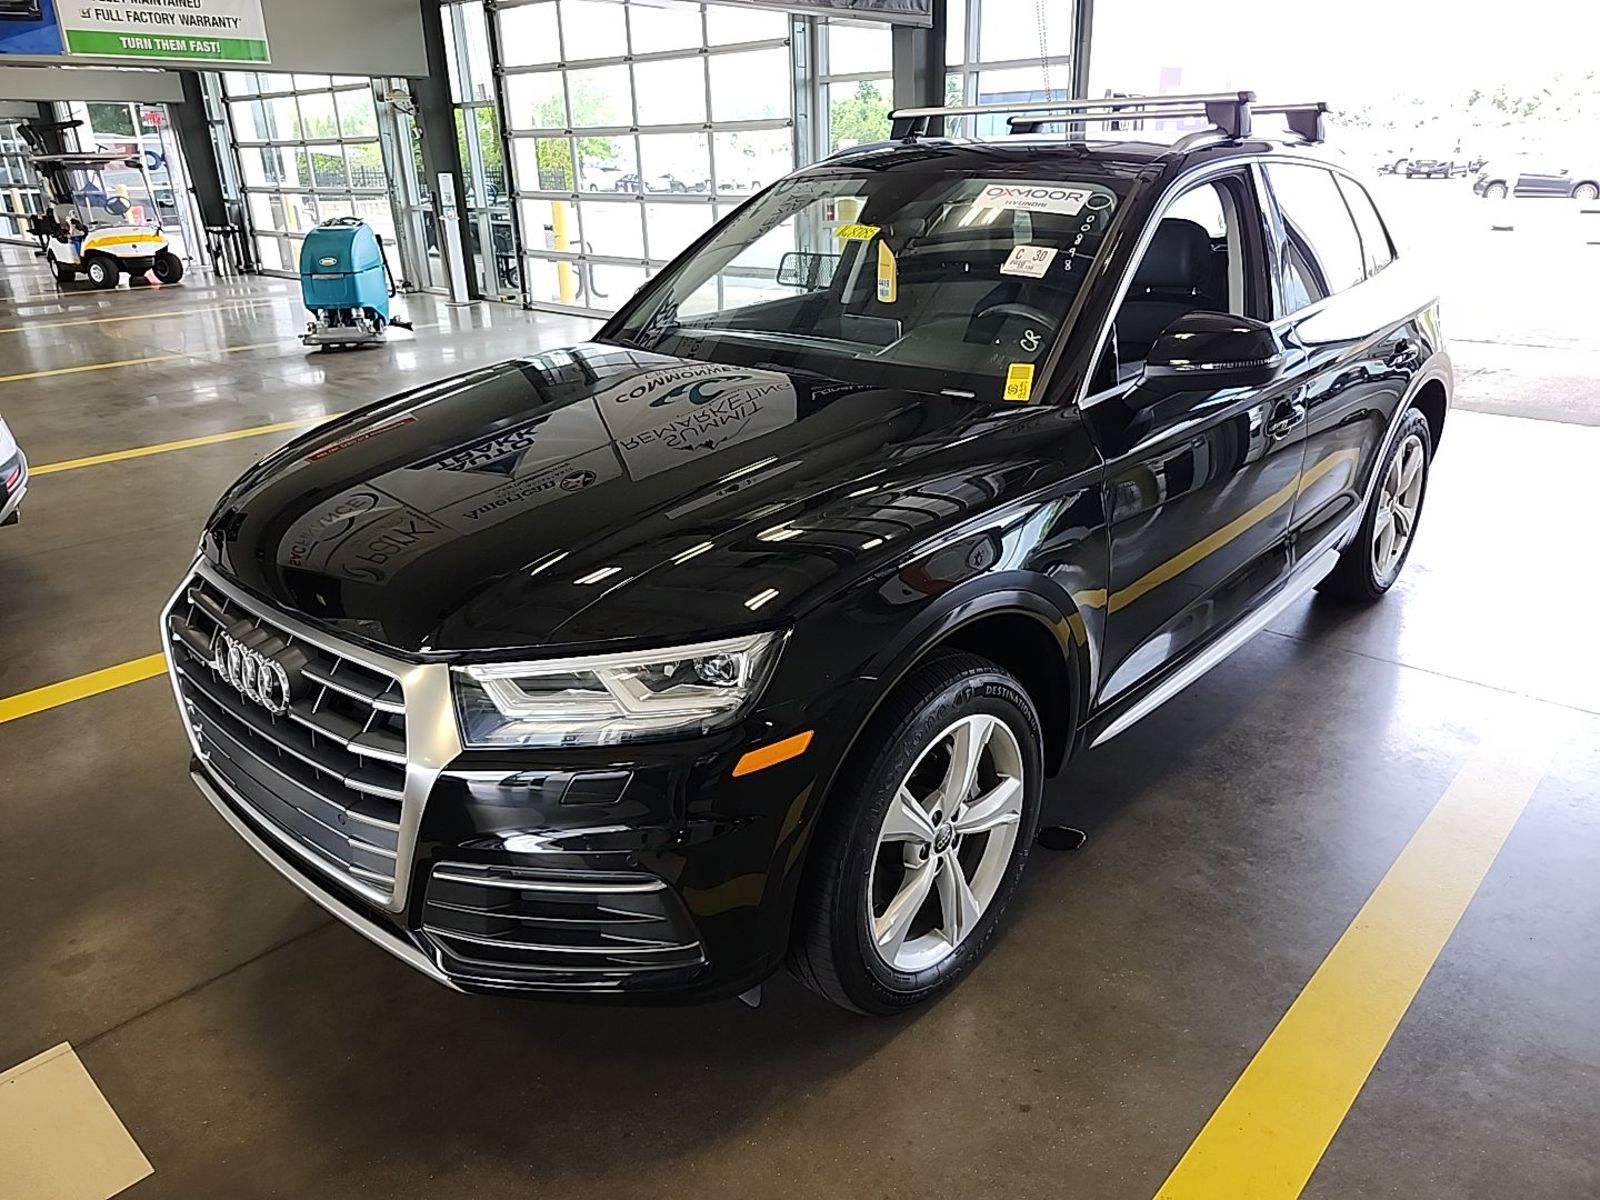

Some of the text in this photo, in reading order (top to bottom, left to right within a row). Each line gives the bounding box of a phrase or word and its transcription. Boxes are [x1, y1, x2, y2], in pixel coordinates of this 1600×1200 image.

[94, 8, 124, 22] FULL
[126, 10, 177, 25] FACTORY
[119, 36, 221, 53] TURN THEM FAST!
[986, 187, 1084, 202] OXMOOR
[1015, 248, 1049, 262] C 30
